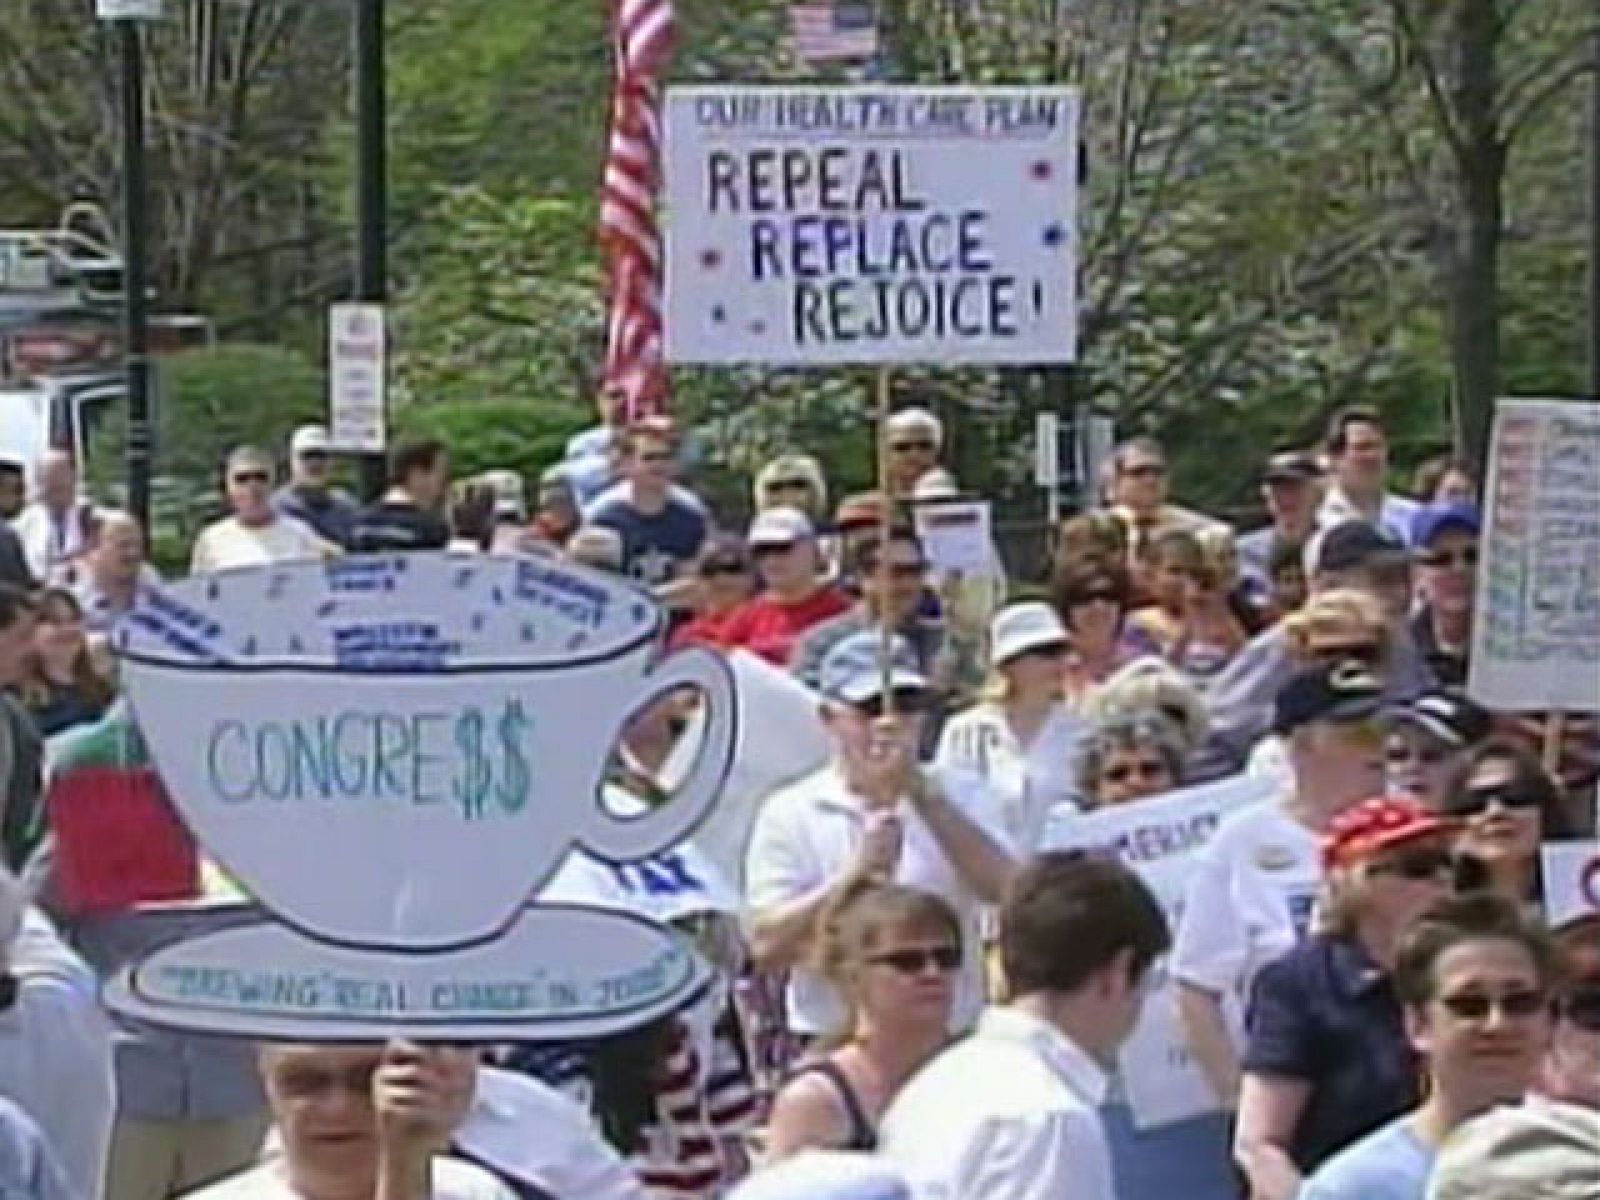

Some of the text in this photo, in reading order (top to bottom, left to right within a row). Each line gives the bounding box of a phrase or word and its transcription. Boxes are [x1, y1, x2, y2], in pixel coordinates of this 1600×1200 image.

[696, 96, 1059, 133] OUR HEALTH CARE PLAN
[708, 148, 926, 213] REPEAL
[751, 212, 991, 280] REPLACE
[794, 276, 1042, 344] REJOICE!
[205, 697, 534, 821] CONGRE$$
